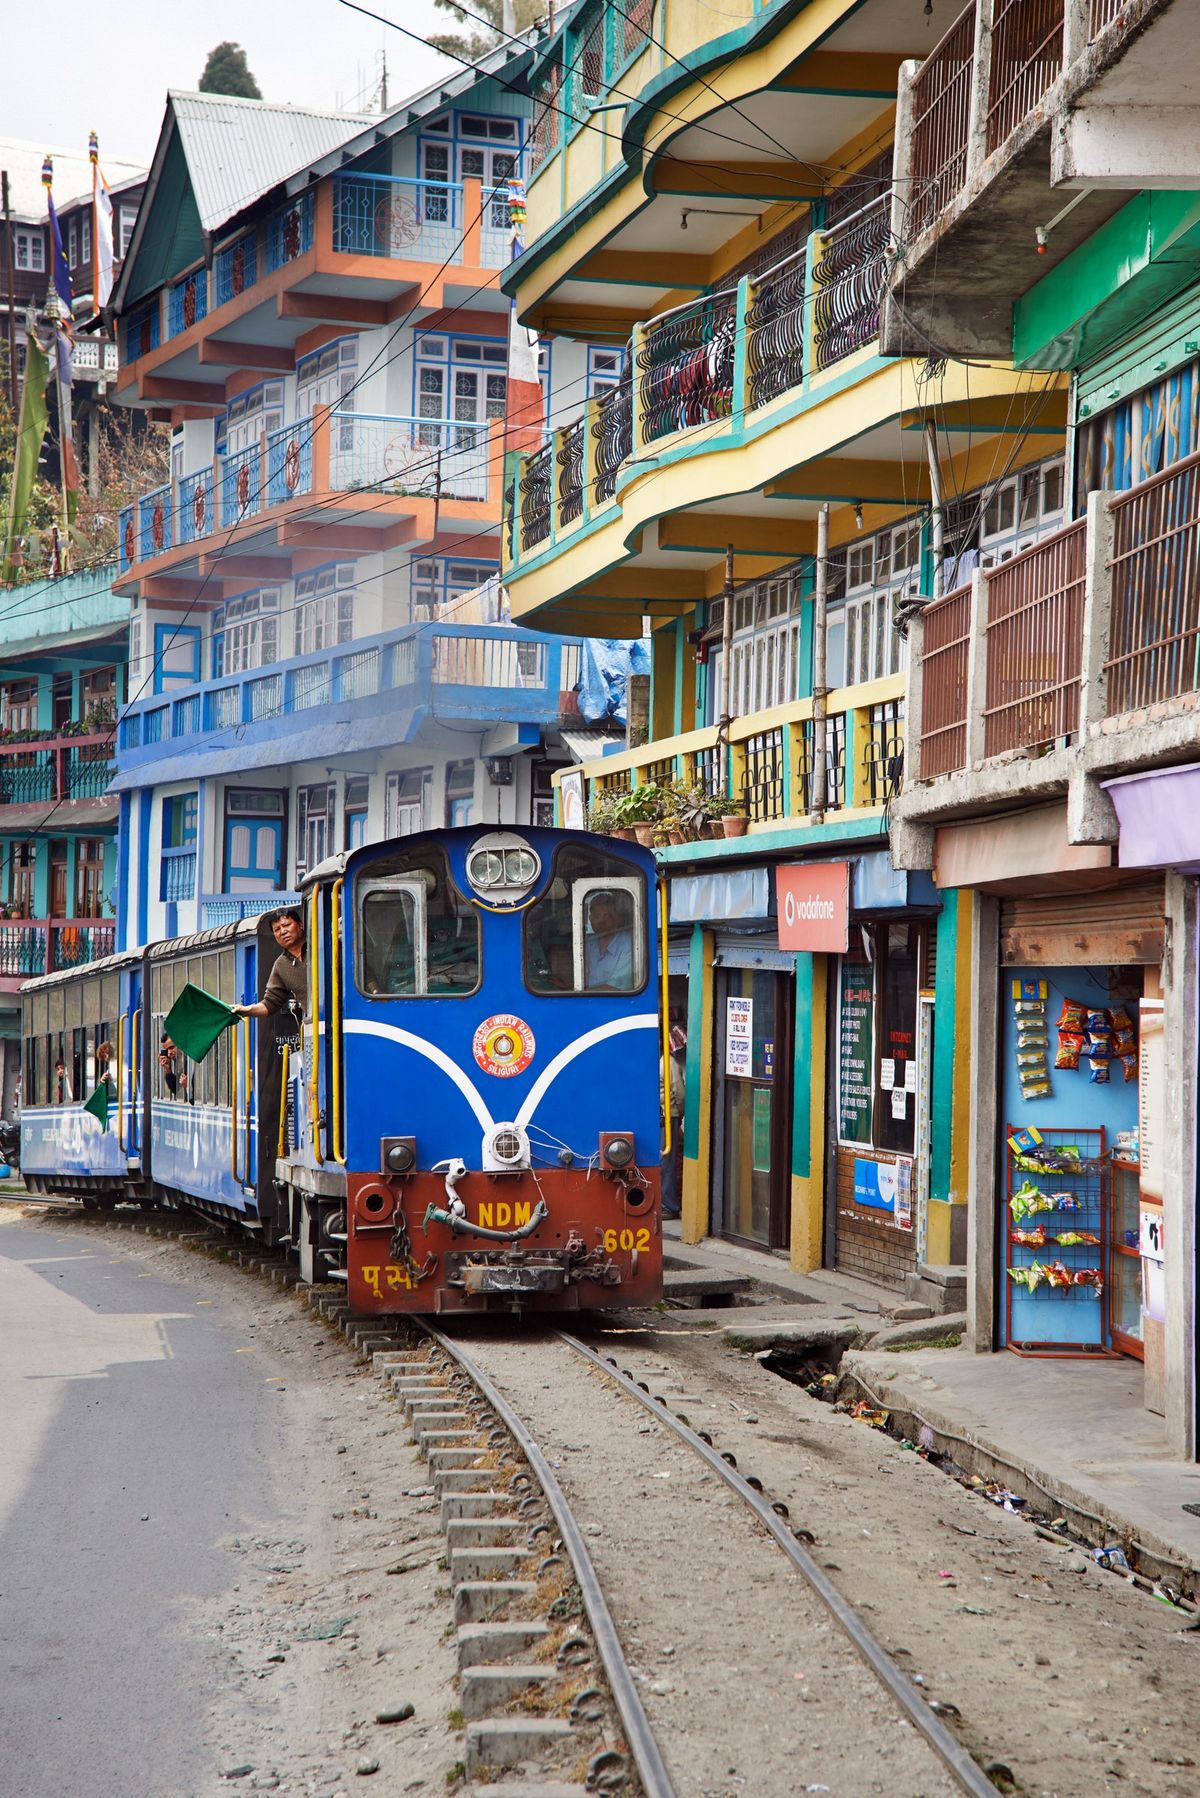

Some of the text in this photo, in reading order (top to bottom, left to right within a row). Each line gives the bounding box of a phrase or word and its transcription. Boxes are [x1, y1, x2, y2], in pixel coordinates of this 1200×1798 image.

[797, 894, 834, 919] vodafone
[493, 1016, 534, 1058] INDIAN RAILWAYS
[488, 1064, 519, 1075] SILIGURI
[478, 1202, 531, 1227] NDM
[604, 1228, 650, 1252] 602
